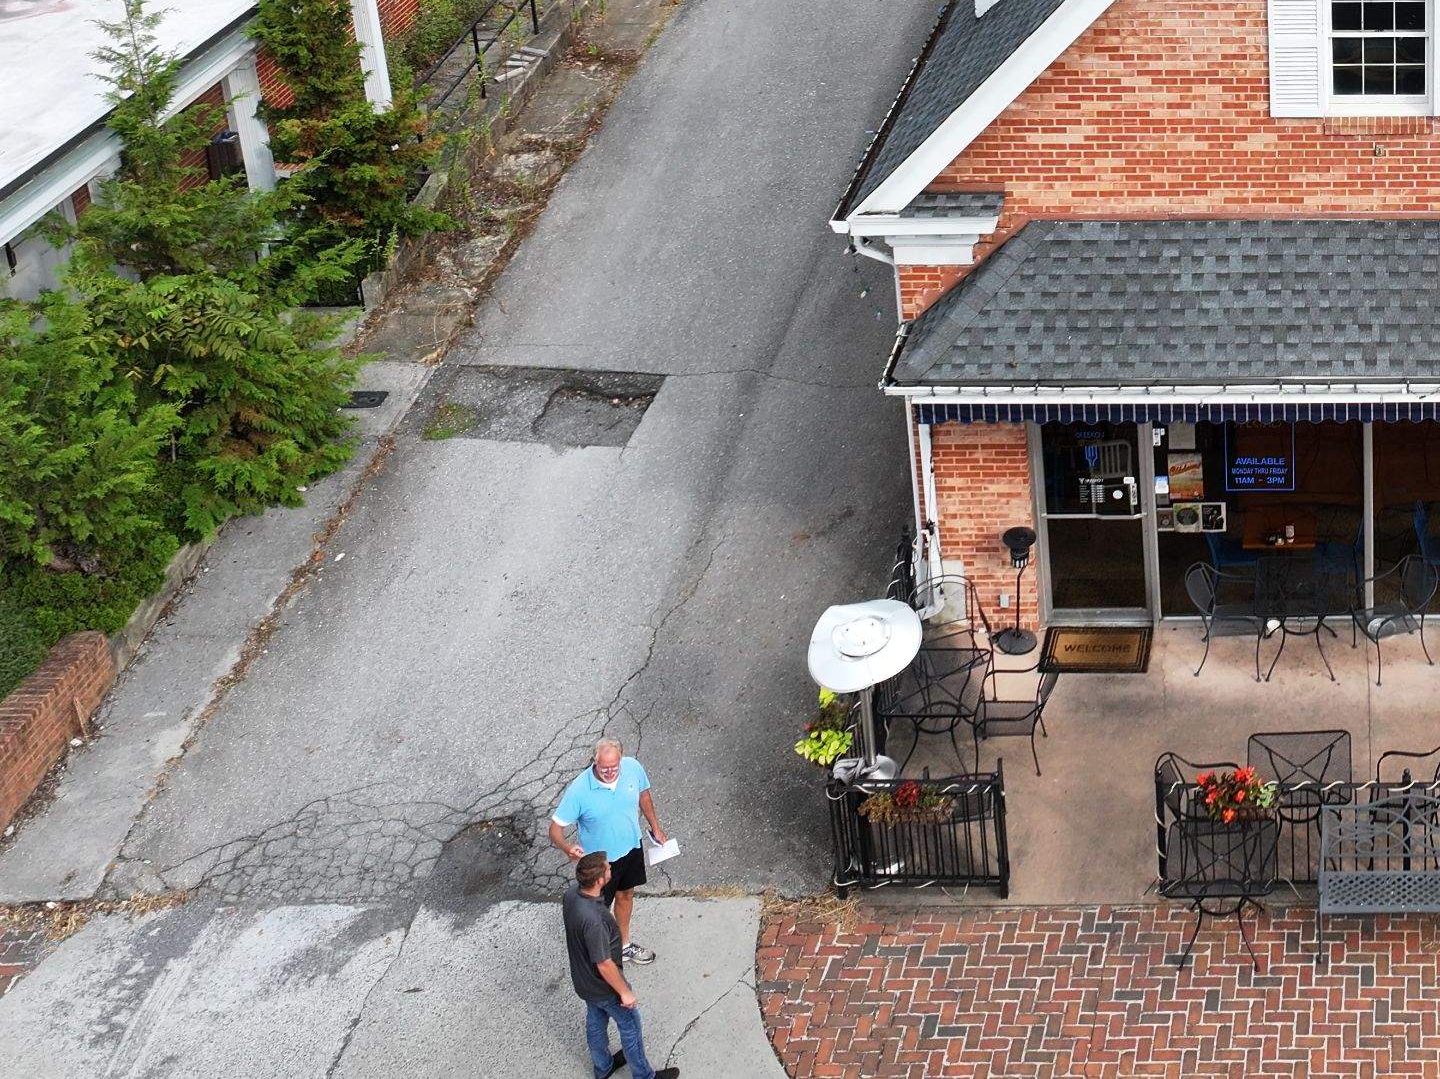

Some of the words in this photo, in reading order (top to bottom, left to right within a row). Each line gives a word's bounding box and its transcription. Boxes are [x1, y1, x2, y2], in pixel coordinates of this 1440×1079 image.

[1235, 457, 1286, 465] AVAILABLE
[1234, 476, 1254, 484] 11AM
[1267, 476, 1285, 484] 3PM
[1064, 644, 1131, 653] WELCOME
